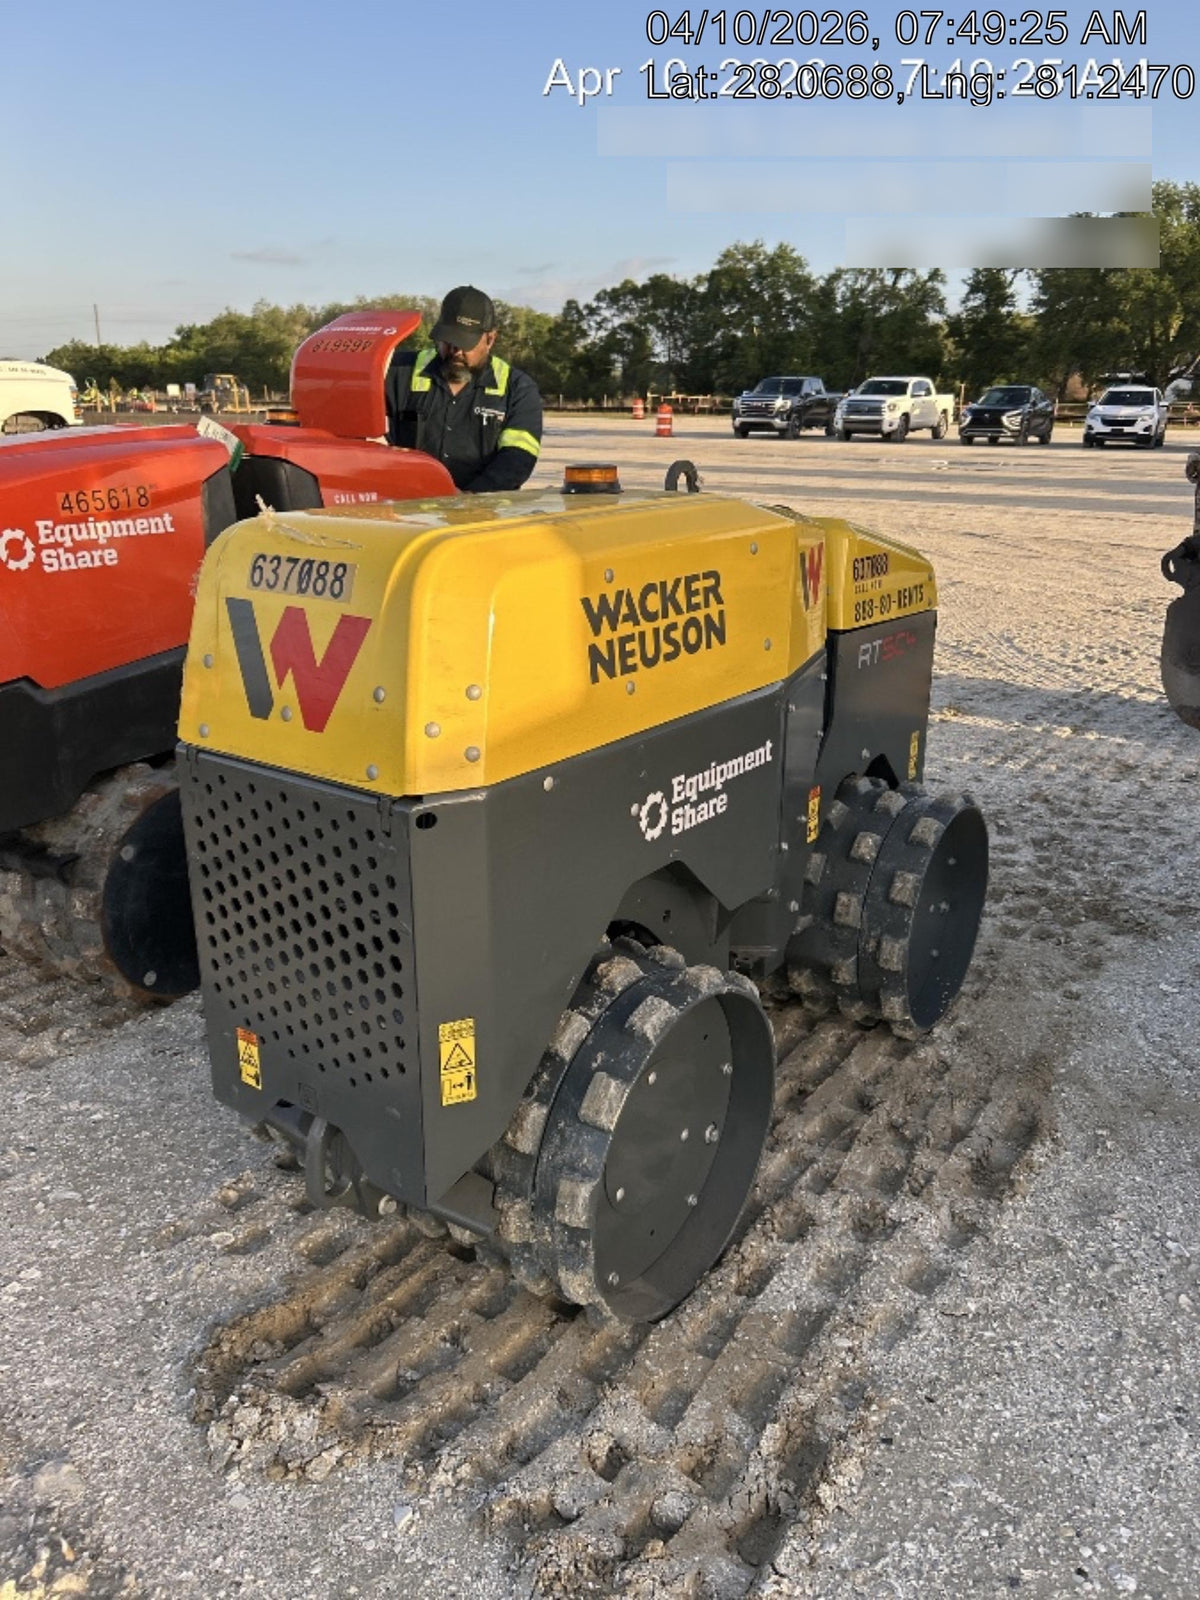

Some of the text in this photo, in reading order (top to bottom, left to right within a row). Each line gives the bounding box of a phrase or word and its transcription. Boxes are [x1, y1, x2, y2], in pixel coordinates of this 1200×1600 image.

[61, 485, 151, 515] 465618
[35, 512, 175, 547] Equipment
[41, 548, 118, 573] Share
[250, 553, 347, 599] 637088
[580, 569, 725, 638] WACKER
[587, 609, 727, 686] NEUSON
[671, 738, 773, 805] Equipment
[671, 792, 729, 837] Share
